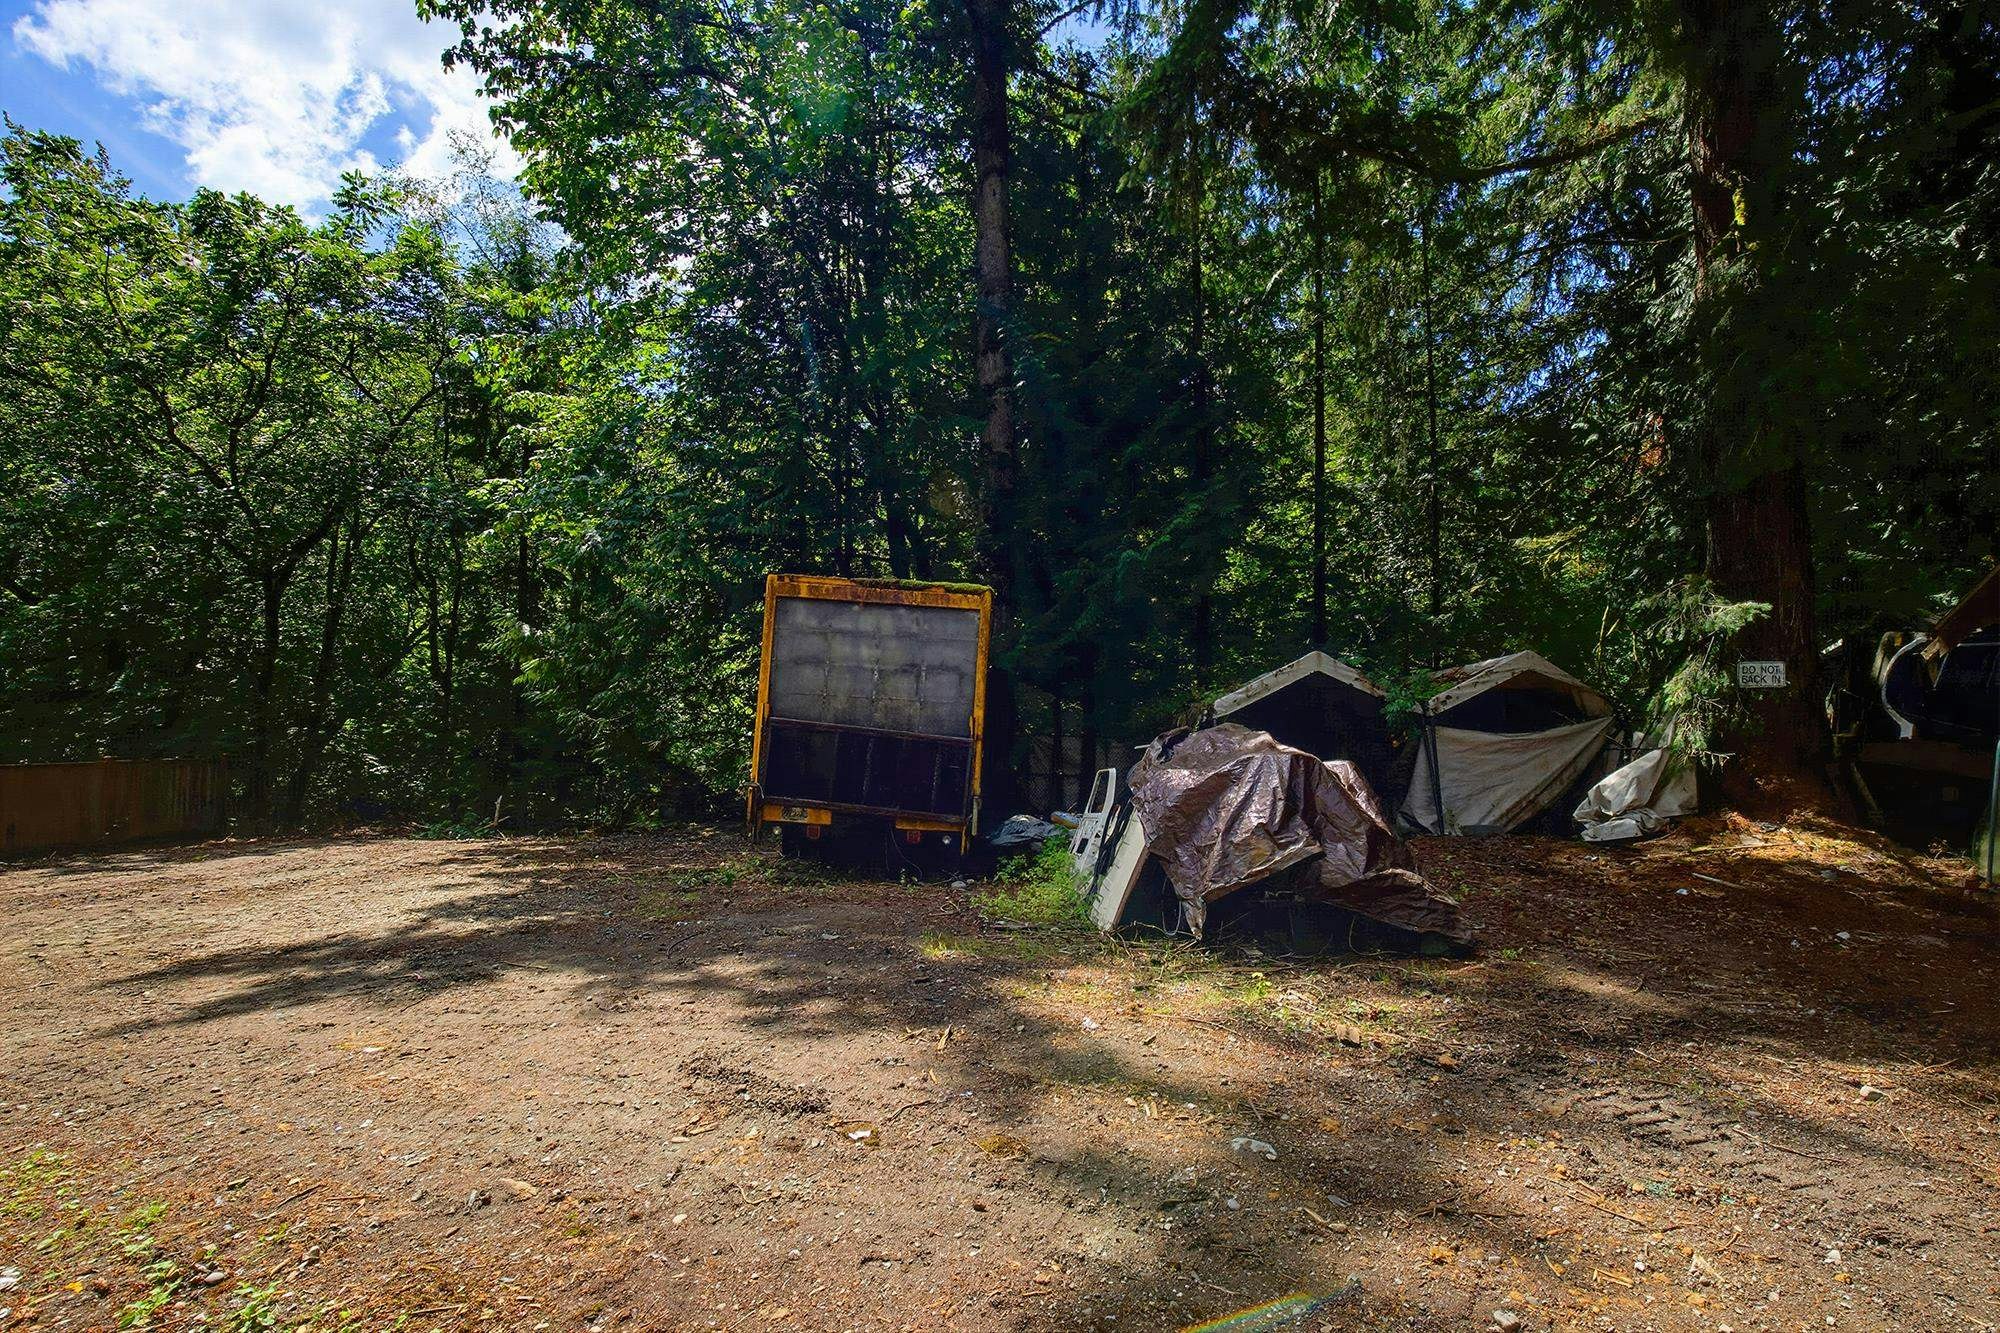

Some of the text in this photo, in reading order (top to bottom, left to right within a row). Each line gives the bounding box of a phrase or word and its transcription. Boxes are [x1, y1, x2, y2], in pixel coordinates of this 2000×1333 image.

[1743, 665, 1780, 674] DO NOT
[1742, 675, 1781, 684] BACK IN
